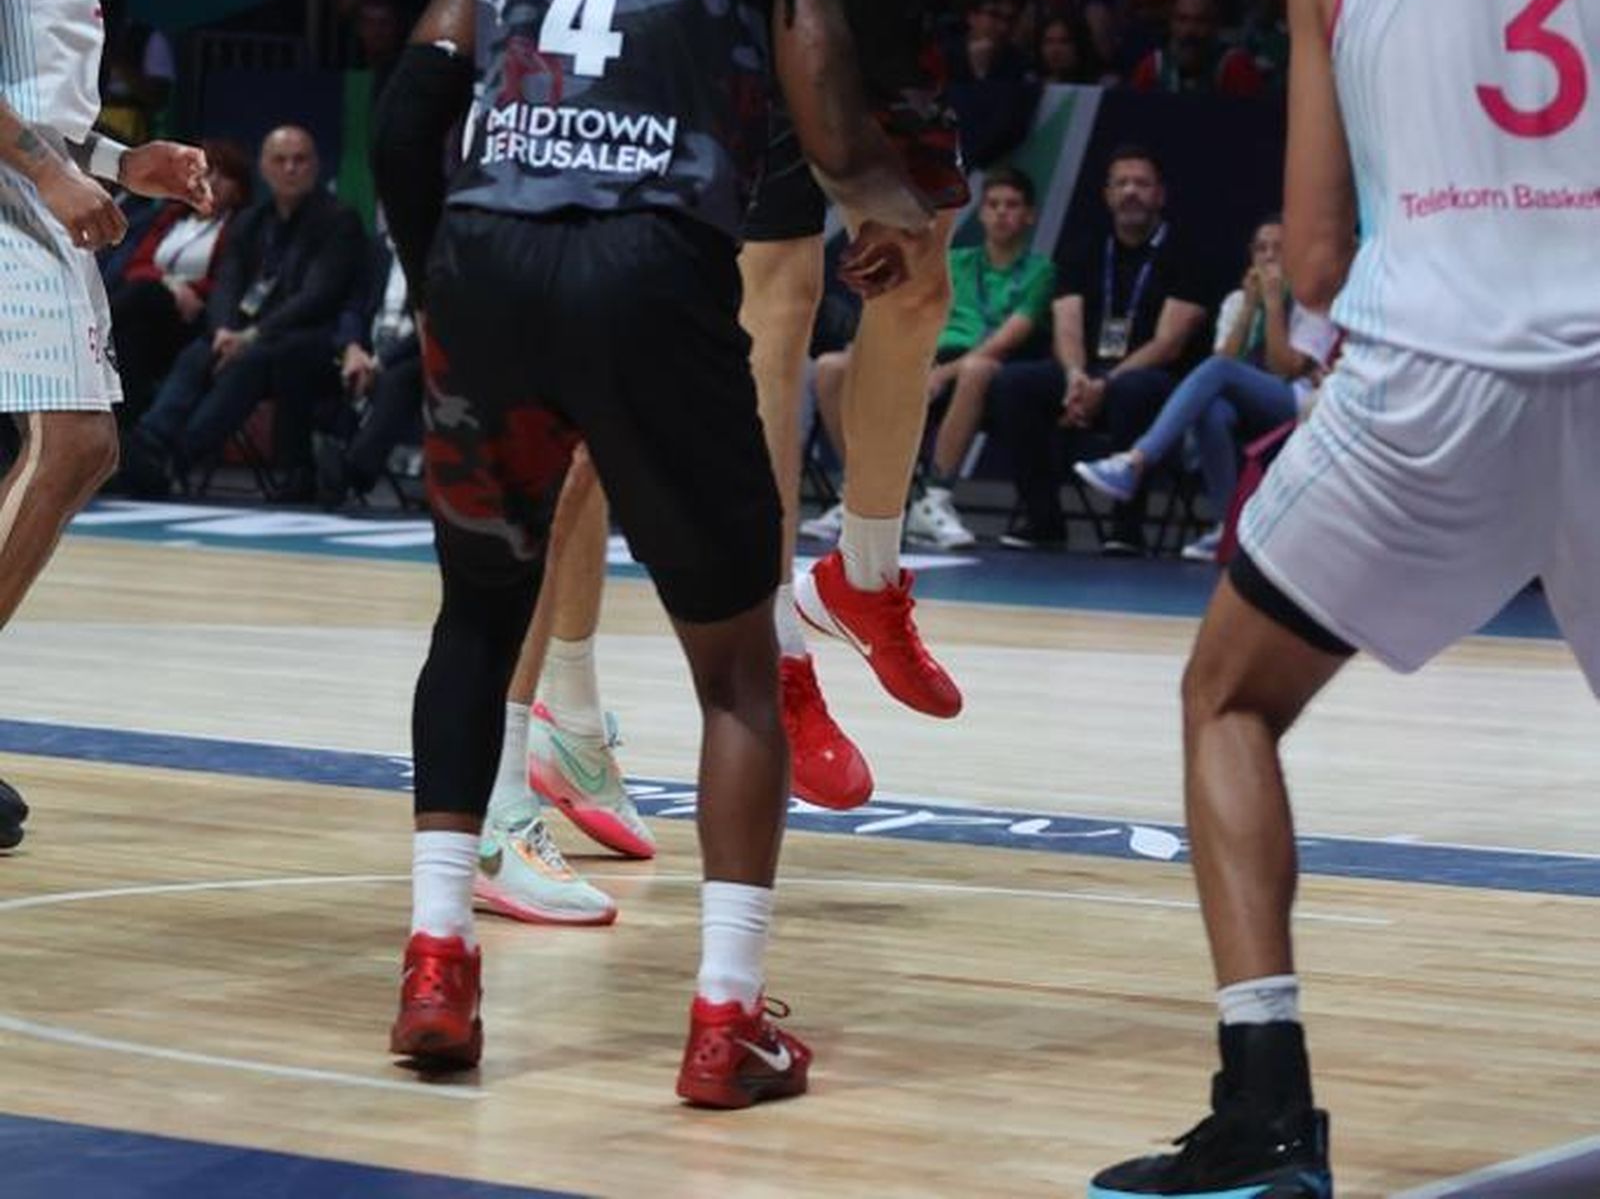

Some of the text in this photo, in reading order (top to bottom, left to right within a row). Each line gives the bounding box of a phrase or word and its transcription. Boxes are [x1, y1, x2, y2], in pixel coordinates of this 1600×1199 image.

[487, 102, 677, 146] MIDTOWN
[480, 132, 673, 176] JERUSALEM
[1400, 183, 1508, 219] Telekom
